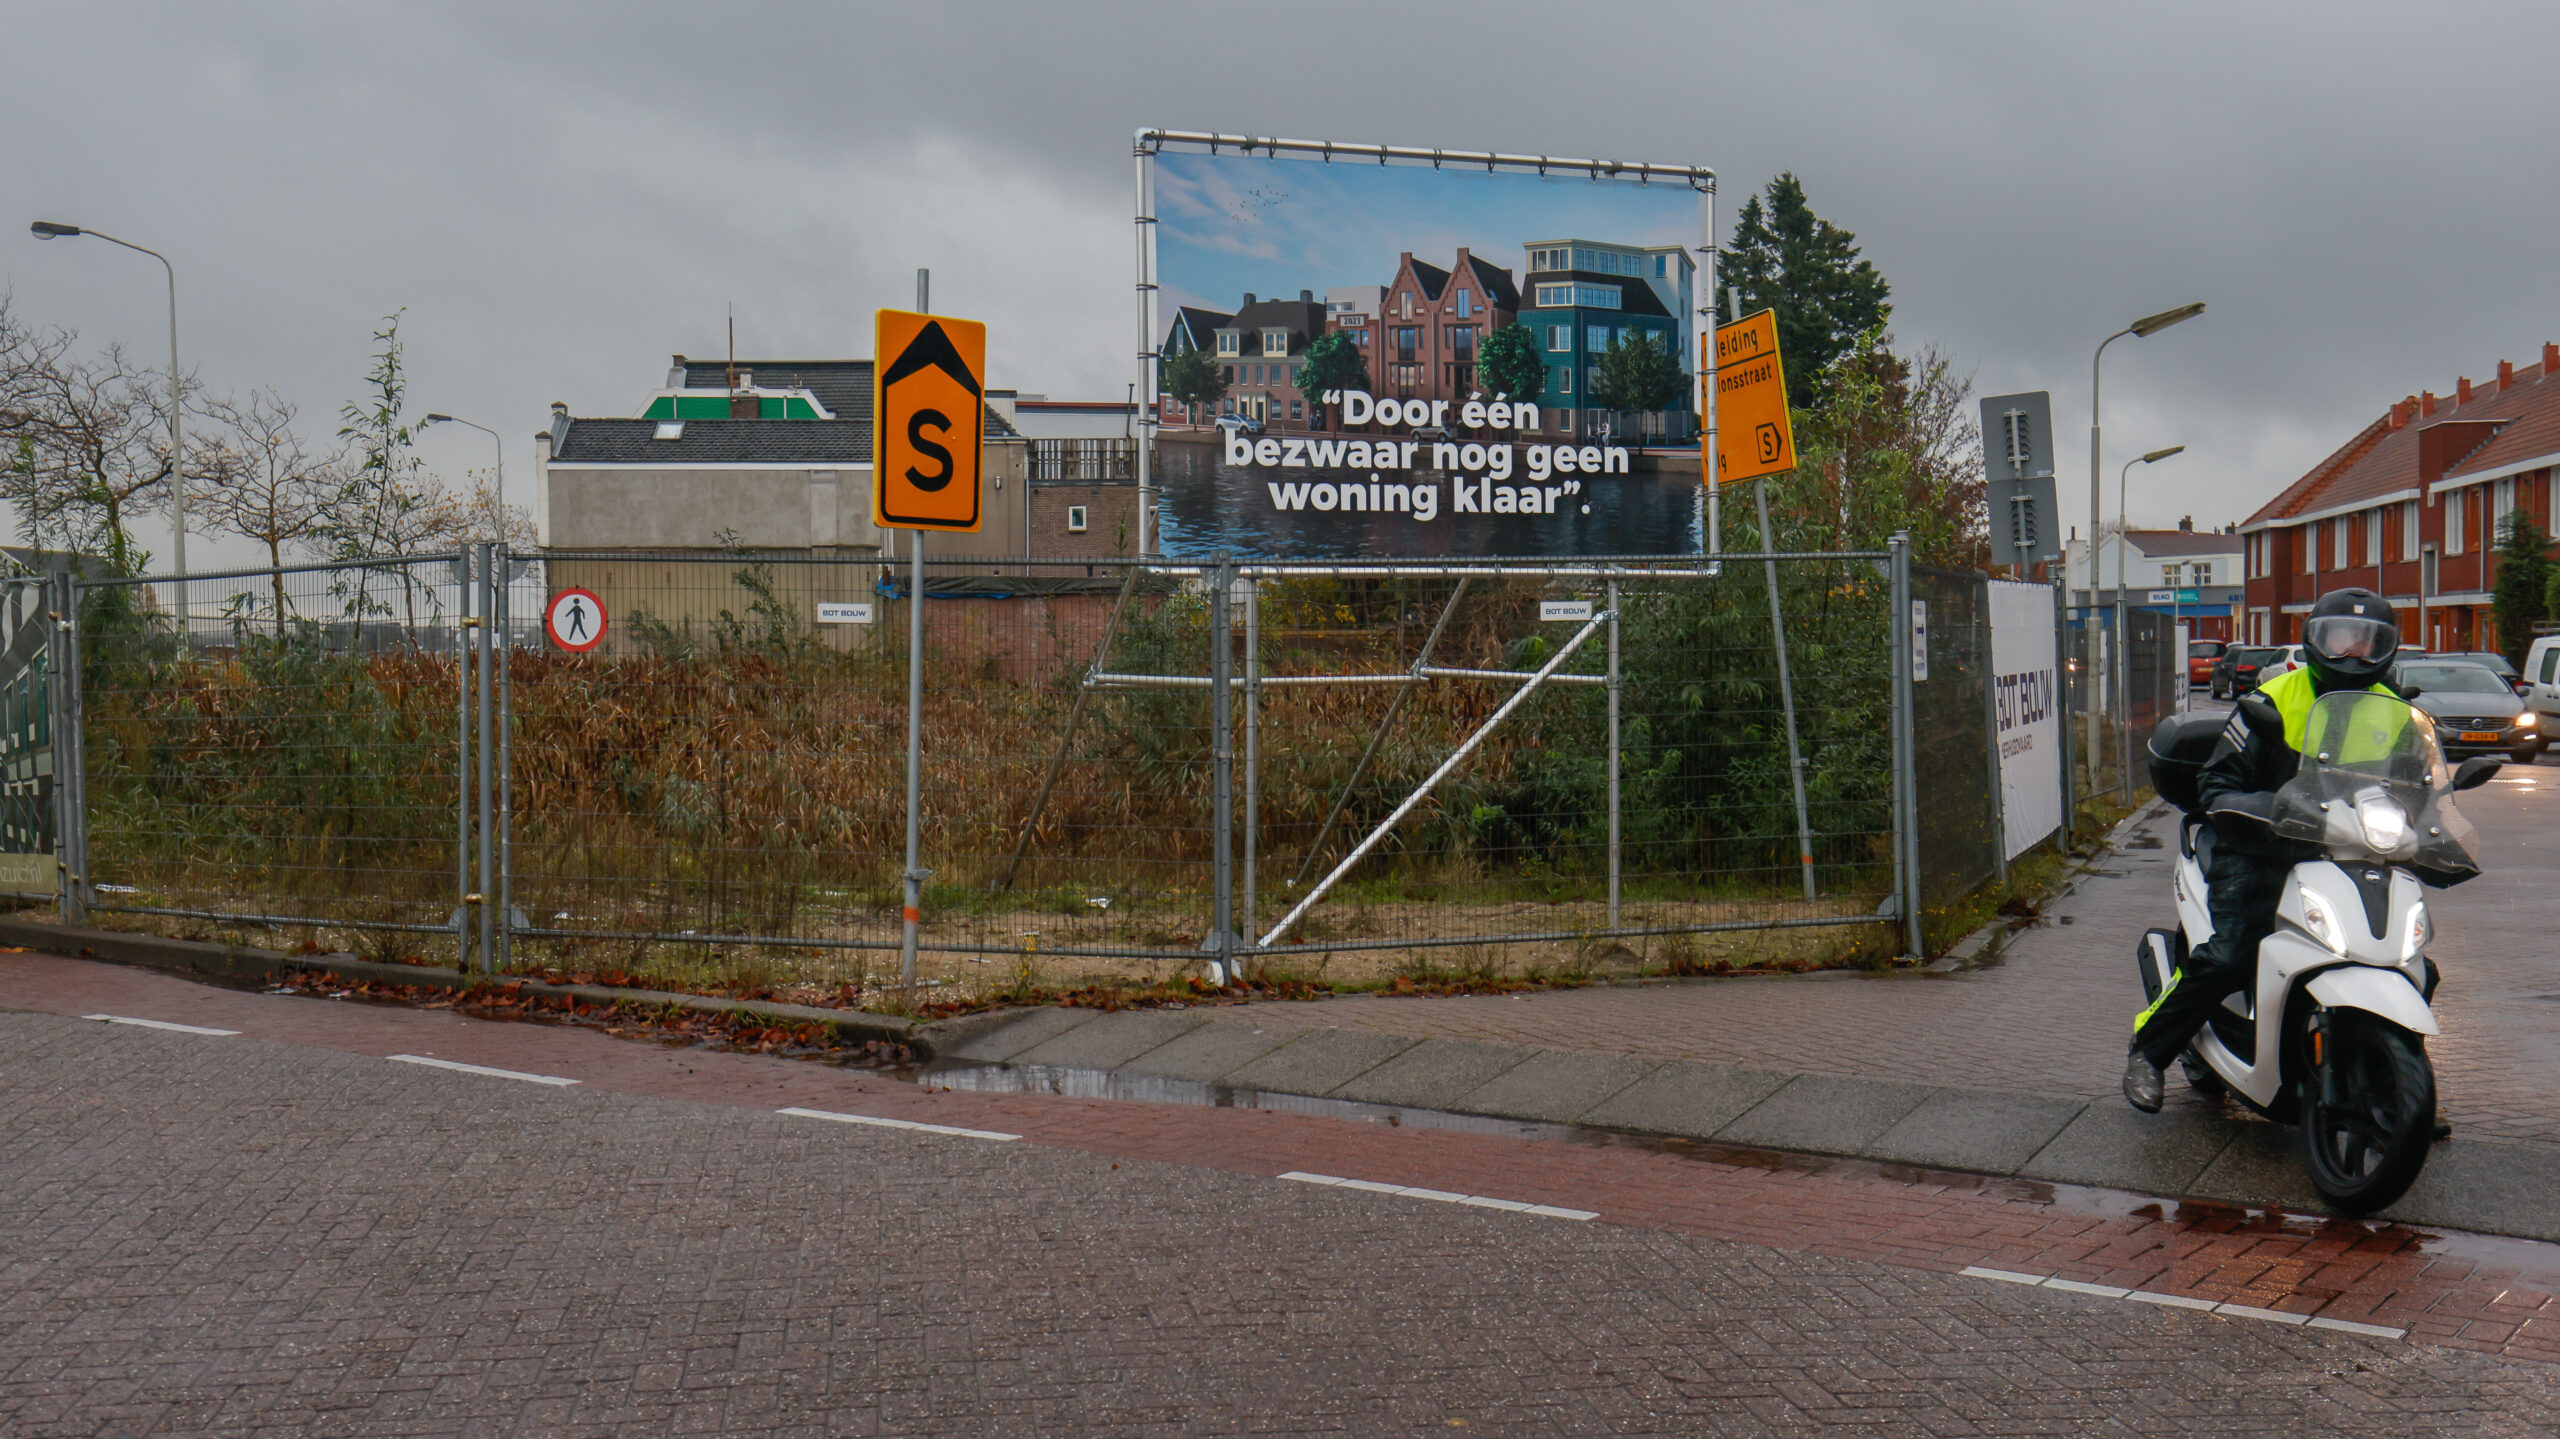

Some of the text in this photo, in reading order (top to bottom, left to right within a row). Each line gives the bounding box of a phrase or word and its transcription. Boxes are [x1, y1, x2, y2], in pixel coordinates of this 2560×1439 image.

[1343, 317, 1361, 325] 2021
[1701, 328, 1758, 365] leiding
[1322, 389, 1539, 429] “Door één
[905, 408, 953, 492] S
[1225, 428, 1629, 480] bezwaar nog geen
[1762, 431, 1773, 456] S
[1268, 473, 1437, 521] woning
[822, 609, 866, 617] BOT BOUW
[1562, 607, 1587, 615] BOUW
[1996, 668, 2052, 732] BOT BOUW
